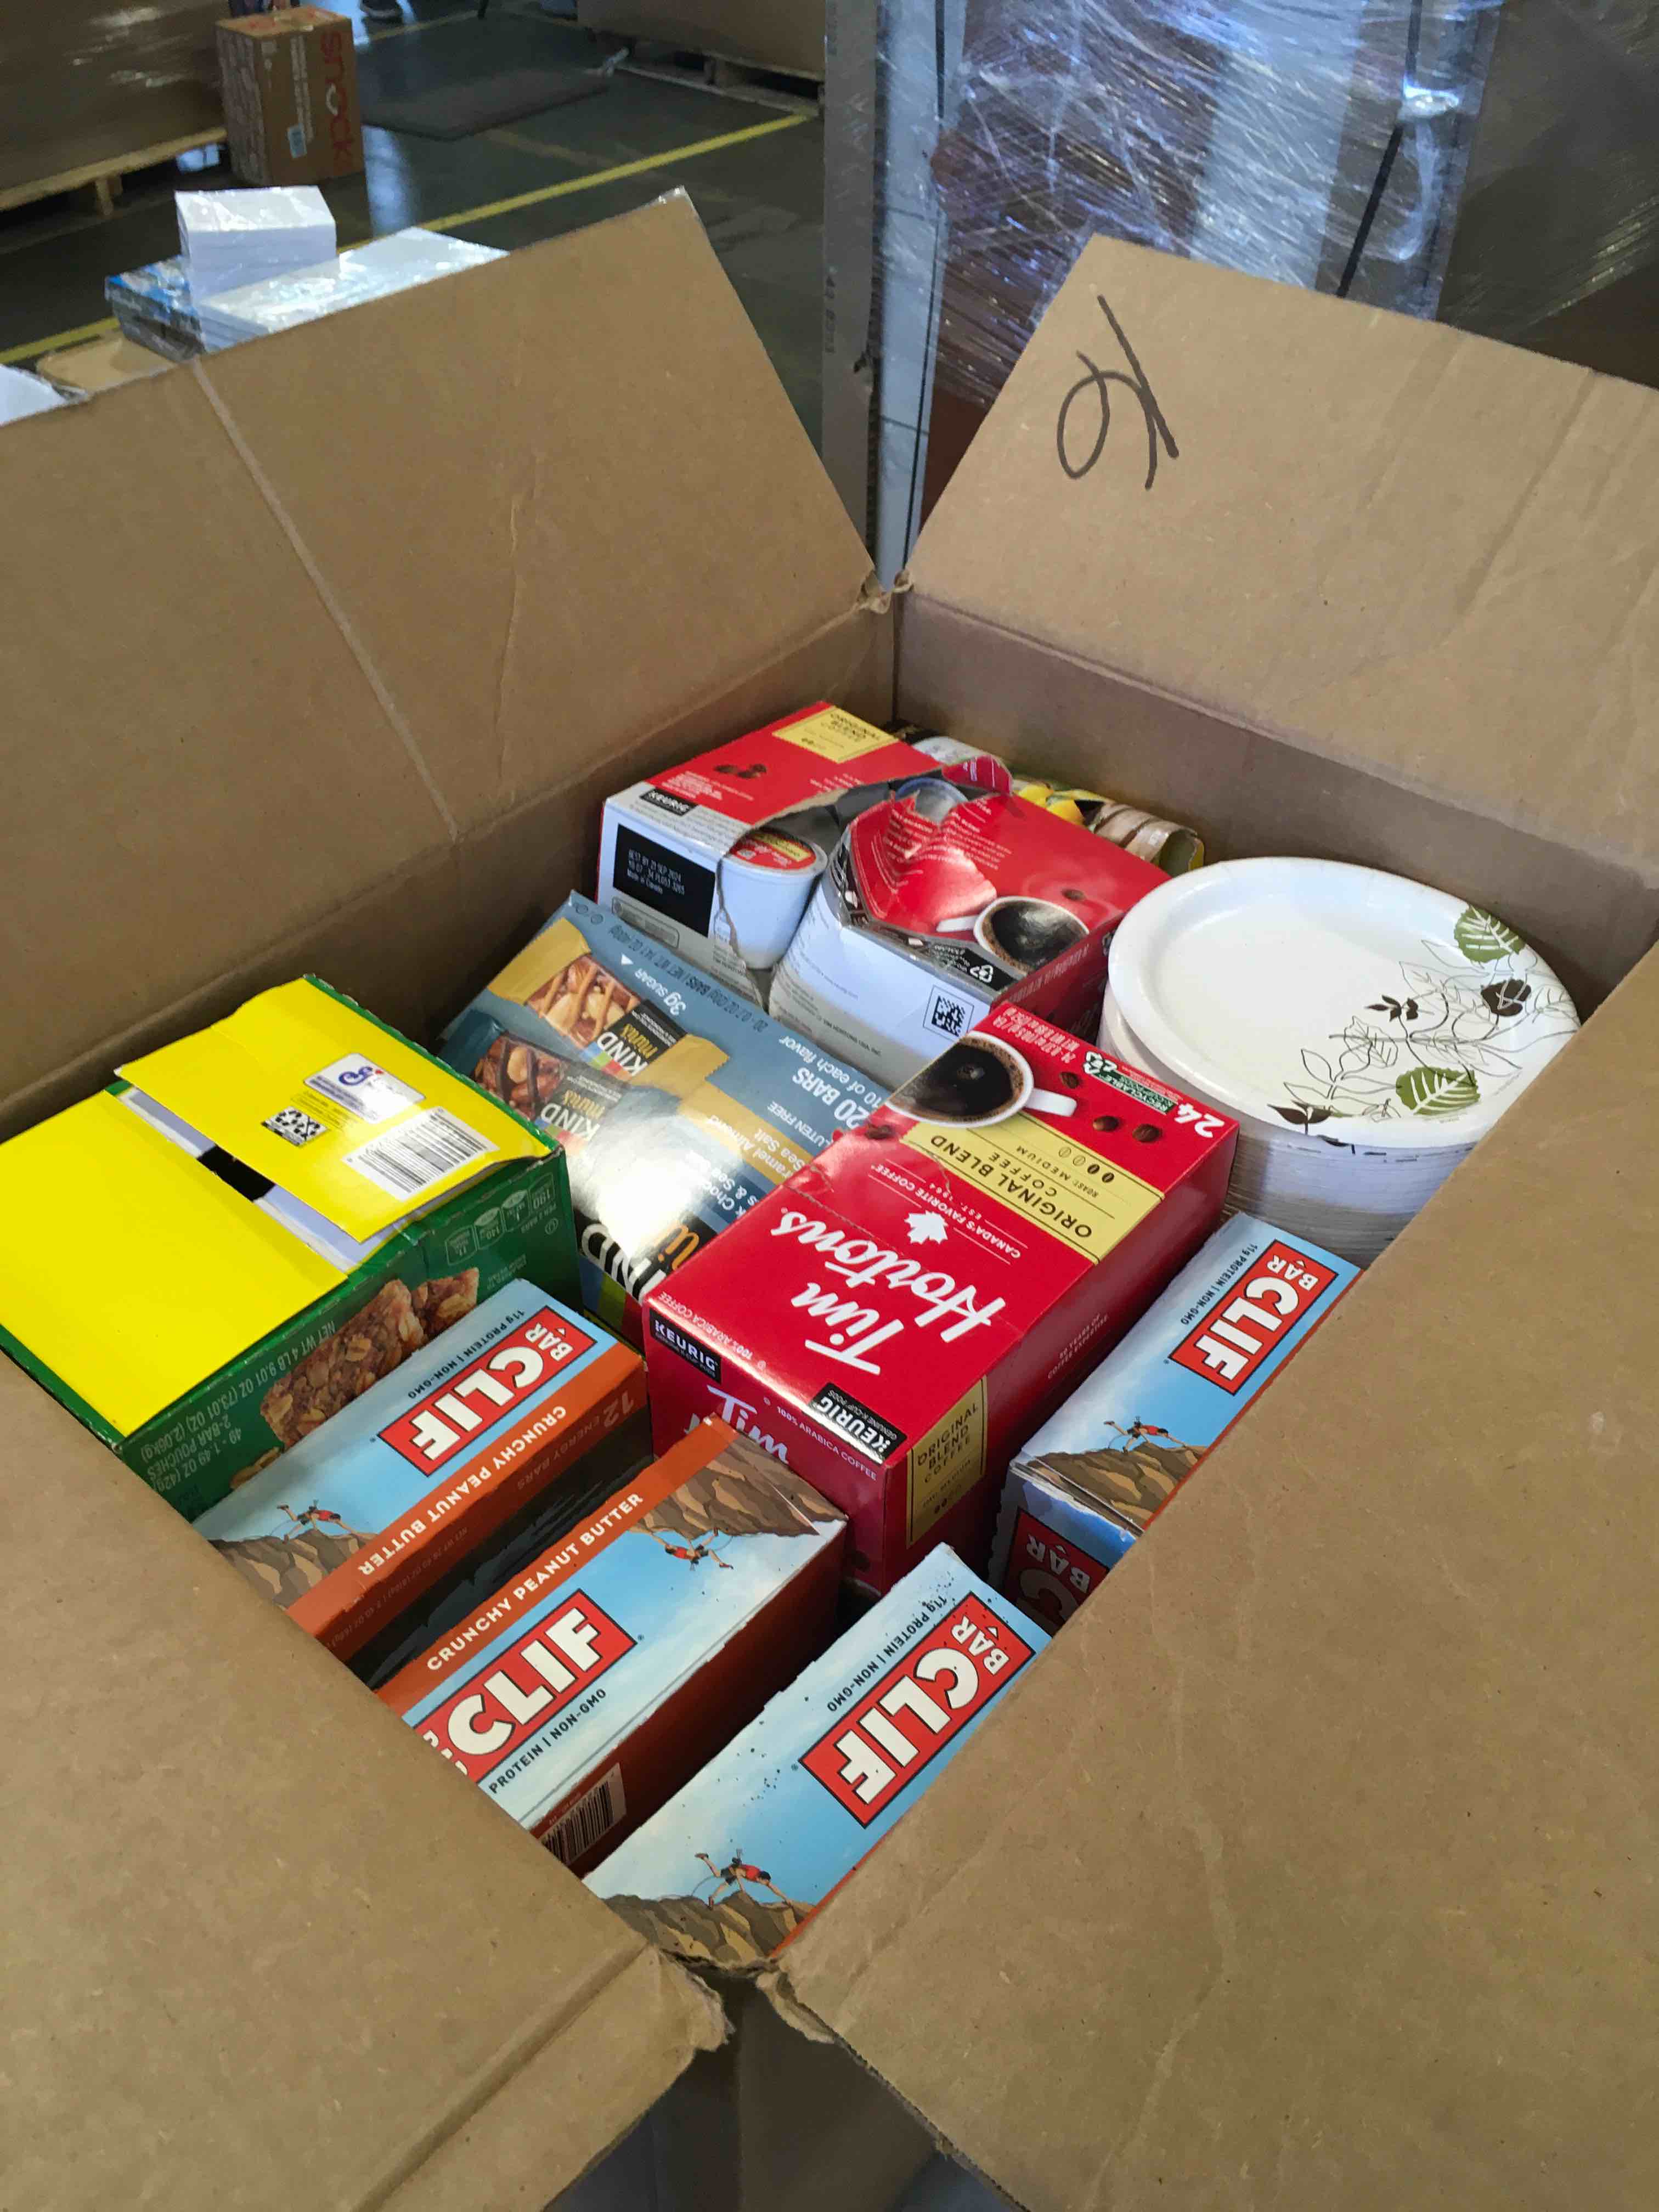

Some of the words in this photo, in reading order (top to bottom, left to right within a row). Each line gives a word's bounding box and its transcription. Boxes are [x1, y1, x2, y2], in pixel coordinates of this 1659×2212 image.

[633, 968, 669, 998] SUGAR
[662, 989, 690, 1017] 3g
[594, 1029, 650, 1076] KIND
[776, 1031, 818, 1065] flavor
[790, 1065, 842, 1108] BARS
[814, 1056, 851, 1086] each
[845, 1079, 866, 1098] of
[766, 1101, 798, 1125] FREE
[831, 1095, 872, 1132] 20
[862, 1090, 883, 1110] 10
[538, 1099, 600, 1144] KIND
[792, 1119, 832, 1150] LUTEN
[1173, 1100, 1225, 1141] 24
[753, 1128, 781, 1153] Salt
[777, 1147, 806, 1171] Sea
[929, 1134, 994, 1178] BLEND
[751, 1146, 795, 1180] ramel
[873, 1163, 916, 1193] COFFEE
[987, 1151, 1059, 1198] COFFEE
[1015, 1144, 1072, 1182] MEDIUM
[913, 1186, 968, 1224] FAVORITE
[960, 1202, 982, 1221] EST.
[995, 1173, 1094, 1240] ORIGINAL
[964, 1220, 1023, 1260] CANADA'S
[770, 1209, 1007, 1343] Hortons
[1214, 1254, 1245, 1288] PROTEIN
[1266, 1254, 1318, 1291] BAR
[657, 1290, 695, 1318] COFFEE
[1179, 1288, 1215, 1326] NON-GMO
[298, 1334, 317, 1356] WT
[314, 1319, 337, 1343] NET
[462, 1321, 506, 1358] PROTEIN
[524, 1322, 574, 1362] BAR
[651, 1319, 718, 1370] KEURIG
[692, 1314, 732, 1345] ARABICA
[789, 1280, 904, 1374] Tim
[1194, 1276, 1296, 1380] CLIF
[254, 1362, 278, 1387] 9.01
[276, 1352, 292, 1371] LB
[406, 1359, 456, 1400] NON-GMO
[238, 1378, 255, 1398] OZ
[409, 1345, 541, 1461] CLIF
[195, 1413, 232, 1447] 2-BAR
[490, 1403, 567, 1470] CRUNCHY
[813, 1395, 891, 1454] KEURIG
[145, 1437, 198, 1481] POUCHES
[179, 1458, 195, 1477] OZ
[195, 1441, 220, 1466] 1.49
[798, 1420, 842, 1454] ARABICA
[840, 1451, 877, 1480] COFFEE
[425, 1464, 492, 1523] PEANUT
[357, 1517, 426, 1576] BUTTER
[1028, 1533, 1091, 1593] BAR
[425, 1596, 514, 1672] CRUNCHY
[514, 1543, 580, 1601] PEANUT
[579, 1491, 644, 1547] BUTTER
[882, 1610, 929, 1658] PROTEIN
[950, 1615, 1009, 1675] BAR
[447, 1606, 603, 1755] CLIF
[826, 1660, 878, 1713] NON-GMO
[488, 1743, 544, 1794] PROTEIN
[551, 1687, 608, 1739] NON-GMO
[833, 1646, 979, 1805] CLIF
